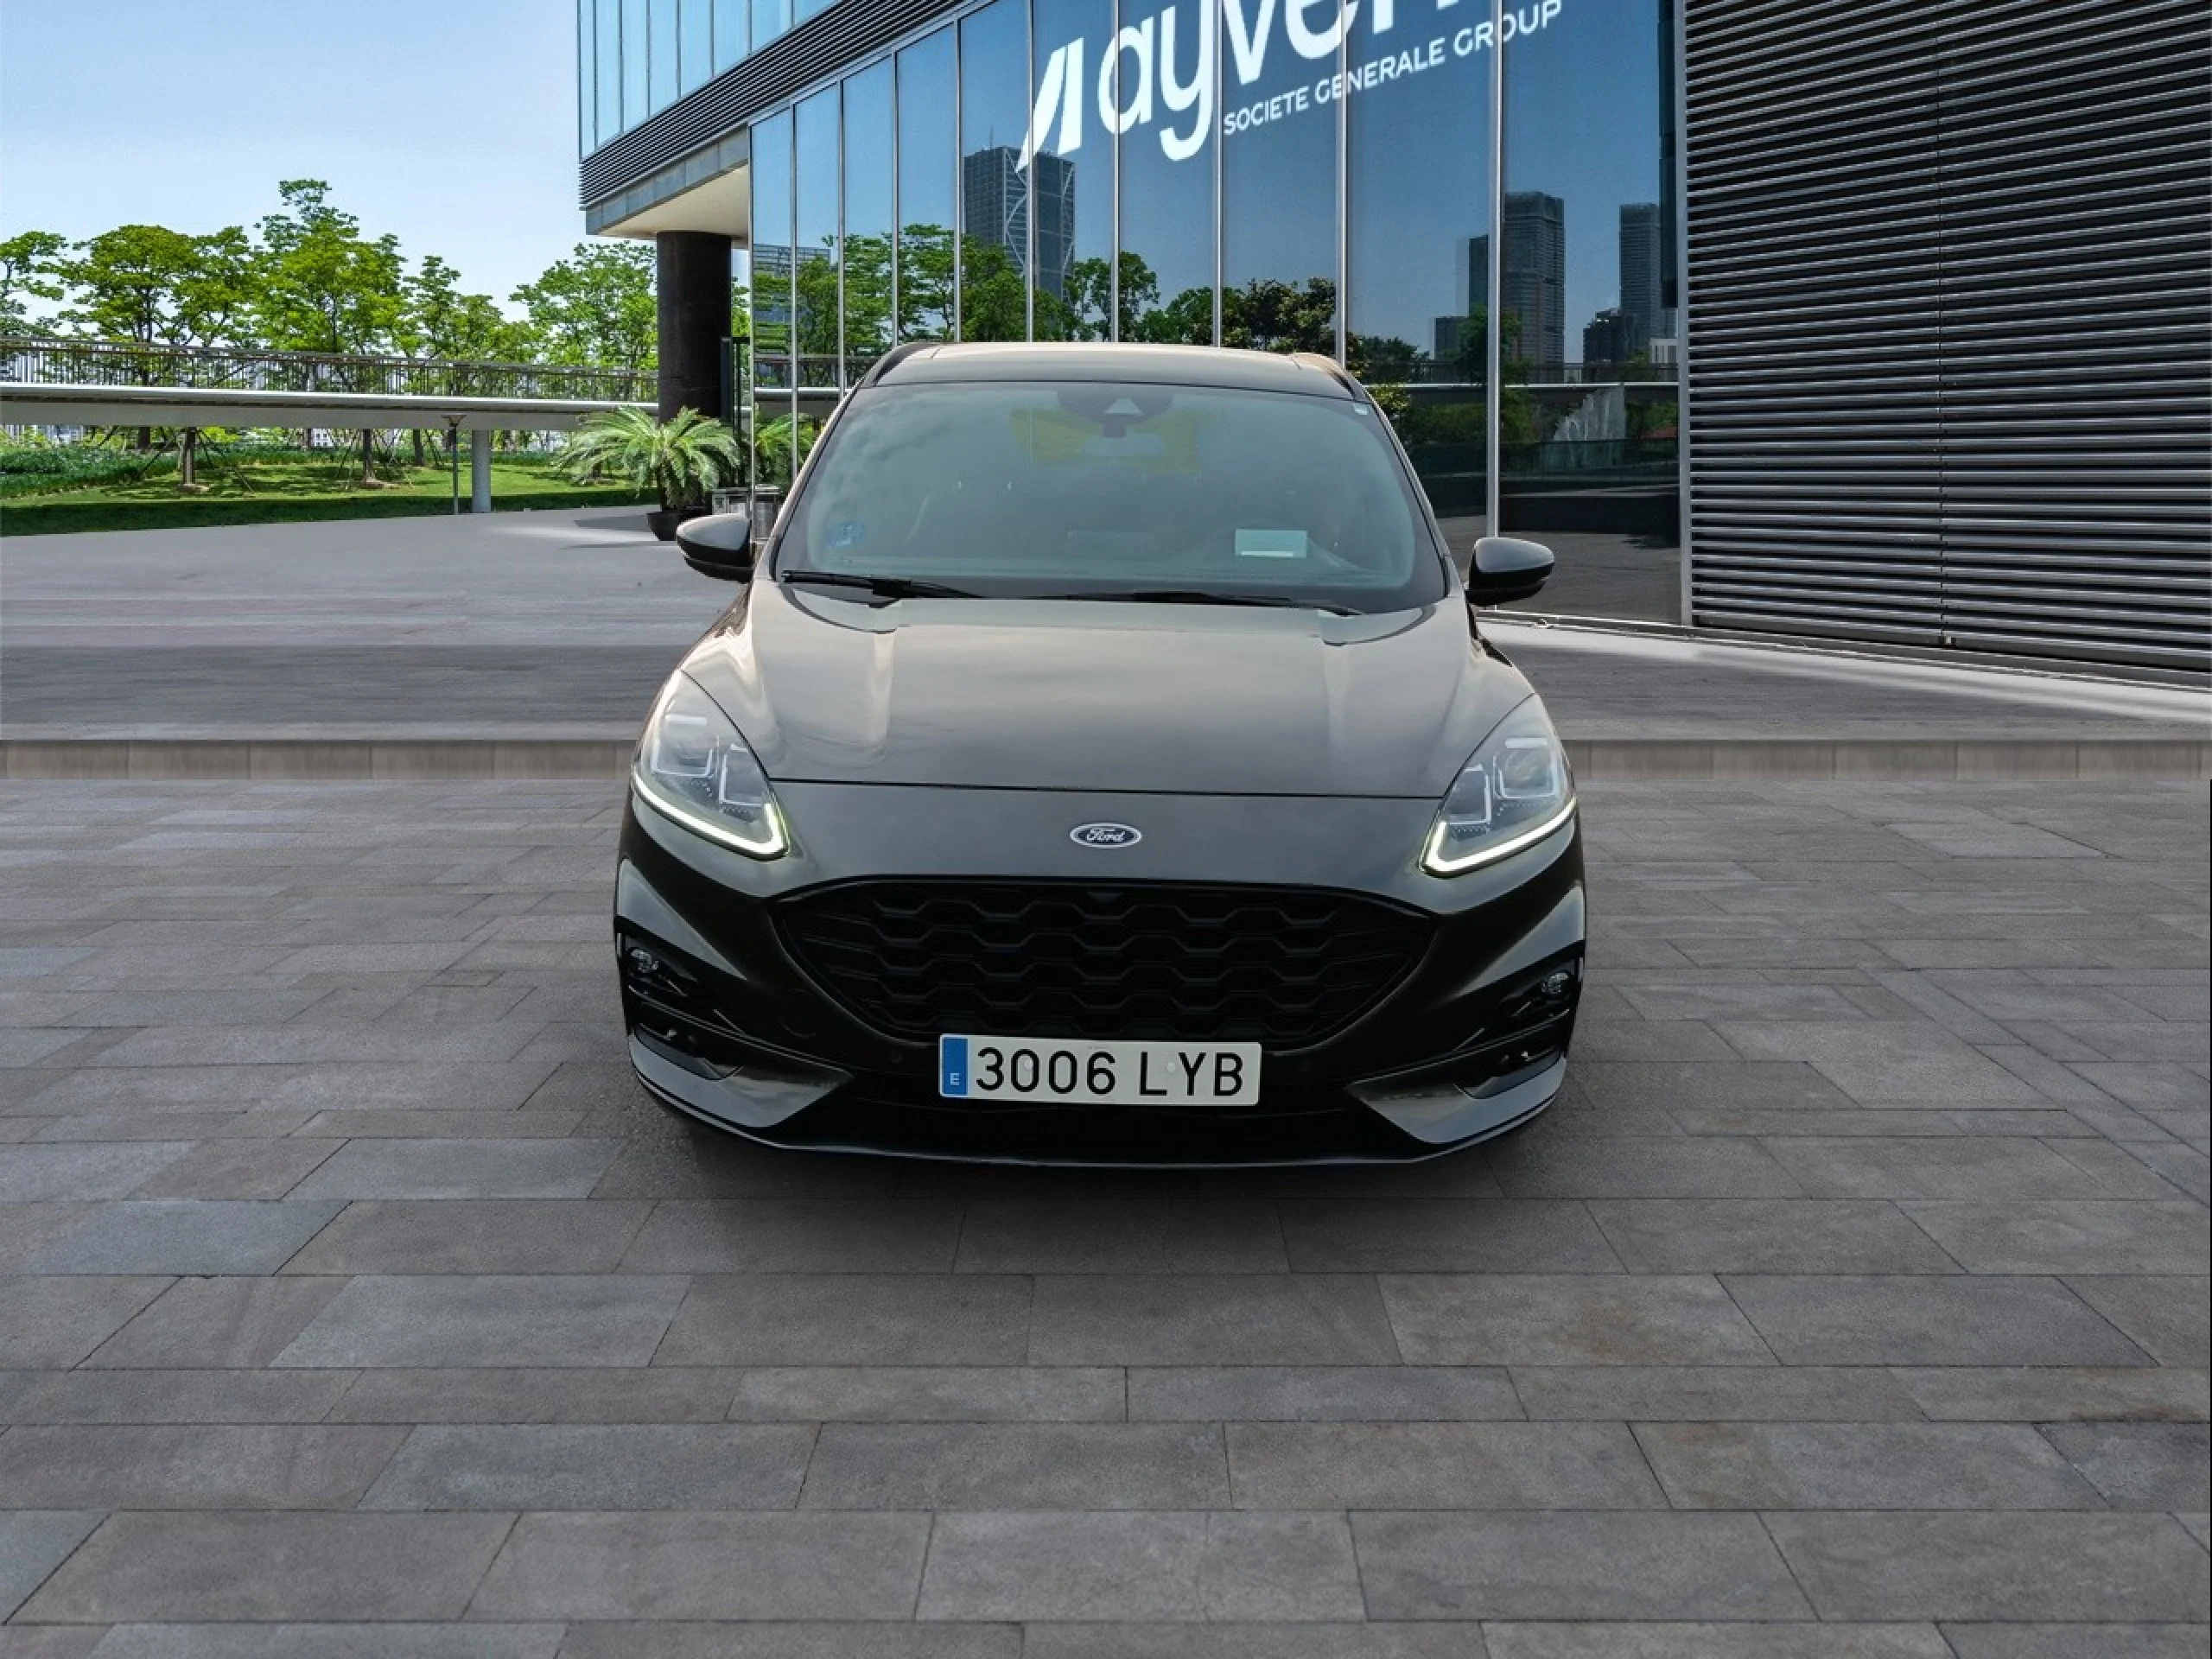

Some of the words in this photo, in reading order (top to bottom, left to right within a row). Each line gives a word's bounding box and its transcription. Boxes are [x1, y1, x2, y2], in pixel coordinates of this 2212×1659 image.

[1224, 86, 1309, 136] SOCIETE
[1315, 38, 1446, 105] GENERALE
[1086, 829, 1126, 842] Ford
[950, 1073, 960, 1085] E
[976, 1047, 1116, 1096] 3006
[1139, 1052, 1243, 1096] LYB
